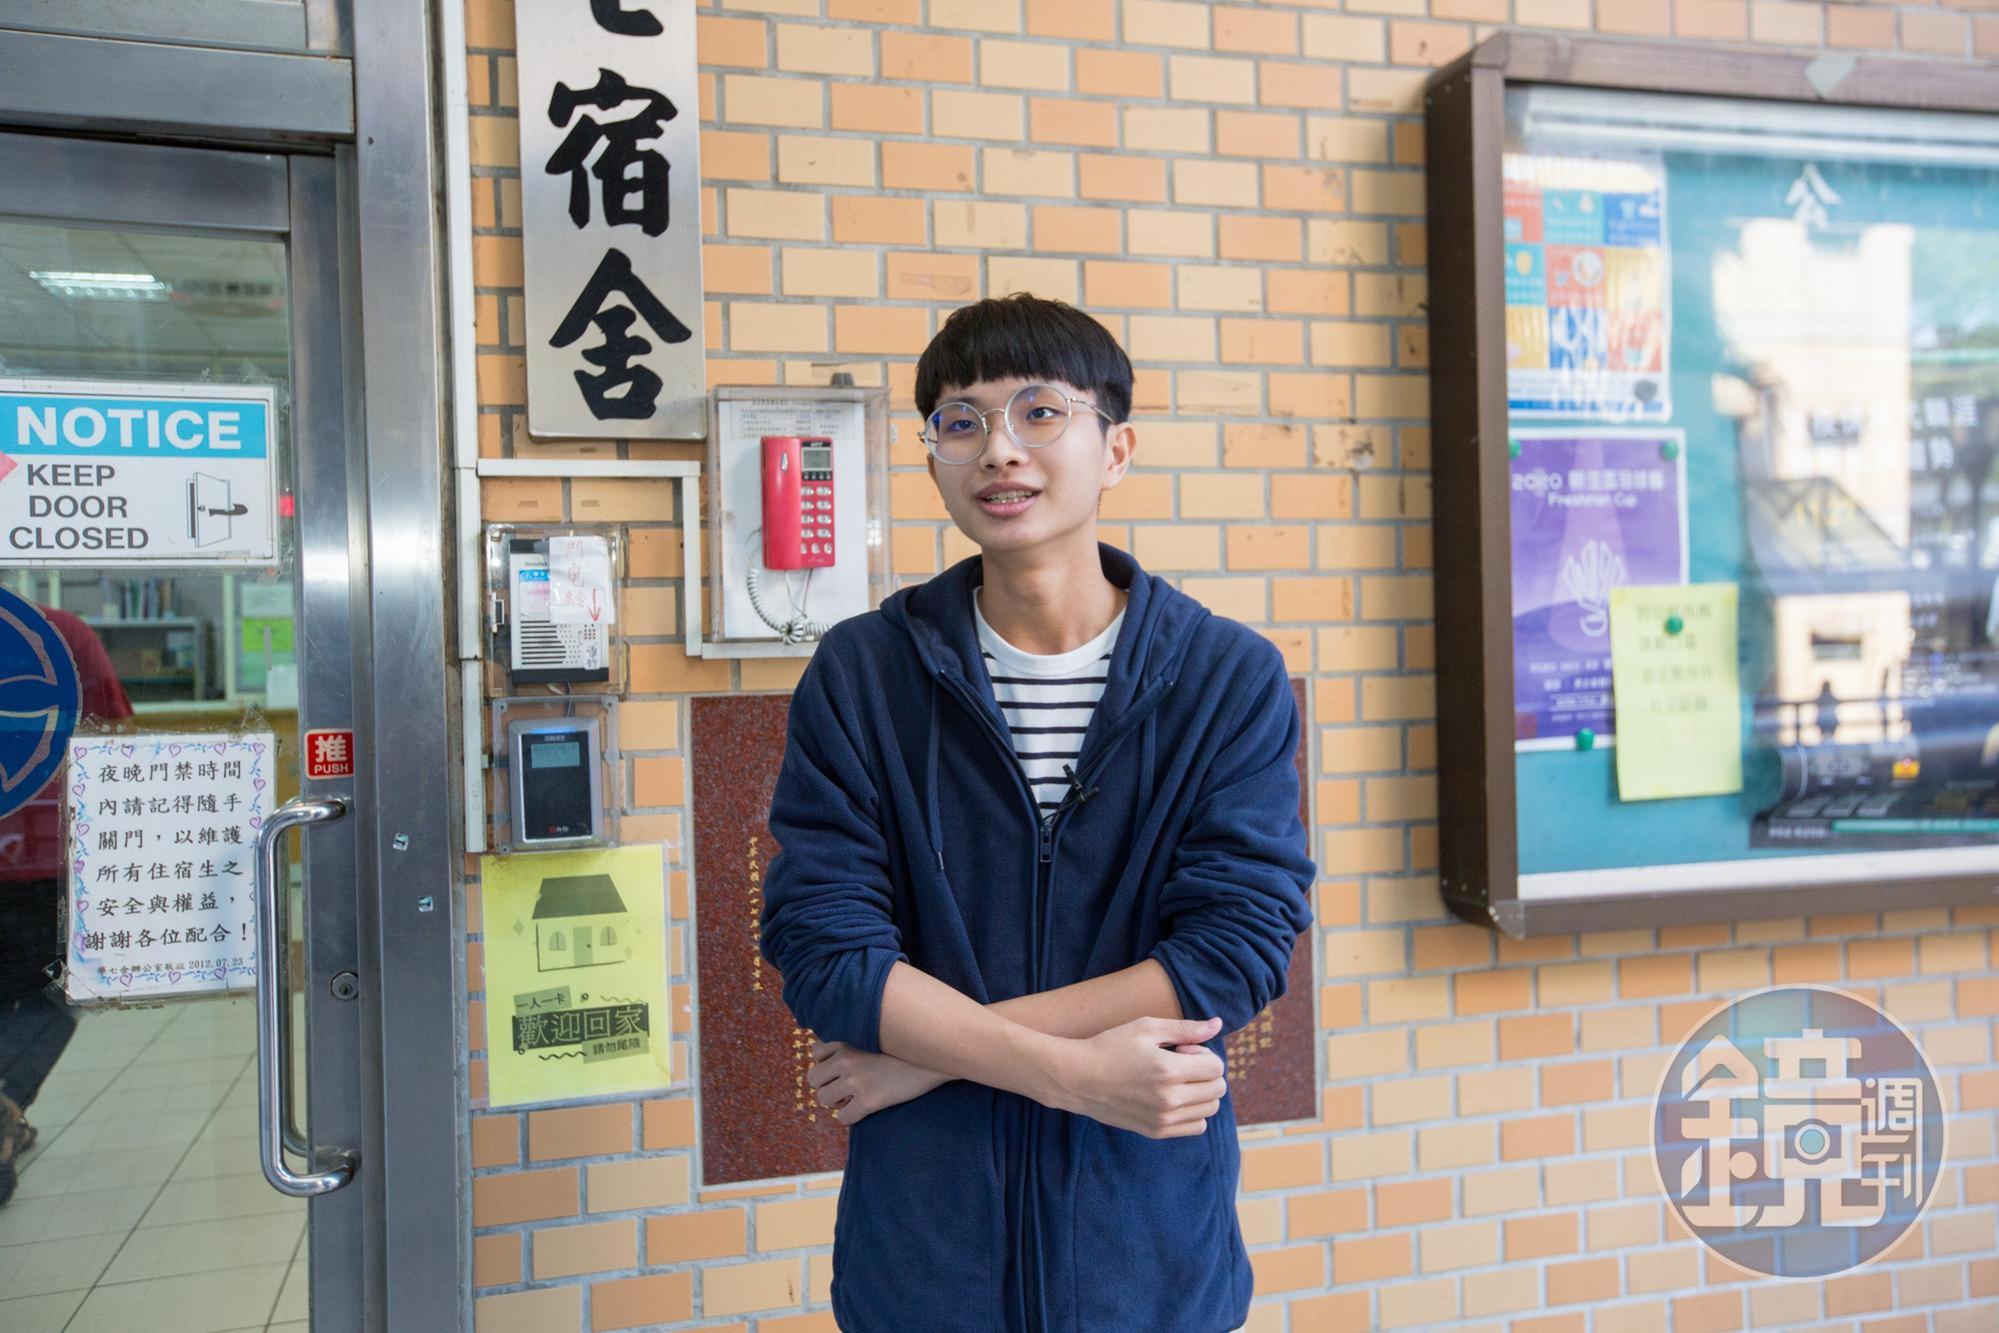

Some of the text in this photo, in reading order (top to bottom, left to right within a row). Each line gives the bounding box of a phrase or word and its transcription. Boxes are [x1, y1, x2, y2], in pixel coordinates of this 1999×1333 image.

[17, 406, 241, 449] NOTICE
[27, 464, 115, 486] KEEP
[29, 495, 128, 518] DOOR
[9, 526, 149, 550] CLOSED
[314, 734, 347, 762] 推
[98, 760, 242, 784] 夜晚門禁時間
[314, 763, 349, 774] PUSH
[98, 793, 242, 816] 內請記得隨手
[98, 825, 243, 851] 關門，以維護
[96, 859, 244, 884] 所有住宿生之
[96, 891, 236, 917] 安全與權益，
[84, 922, 248, 951] 謝謝各位配合！
[516, 992, 566, 1010] 一人一卡
[518, 1006, 644, 1047] 歡迎回家
